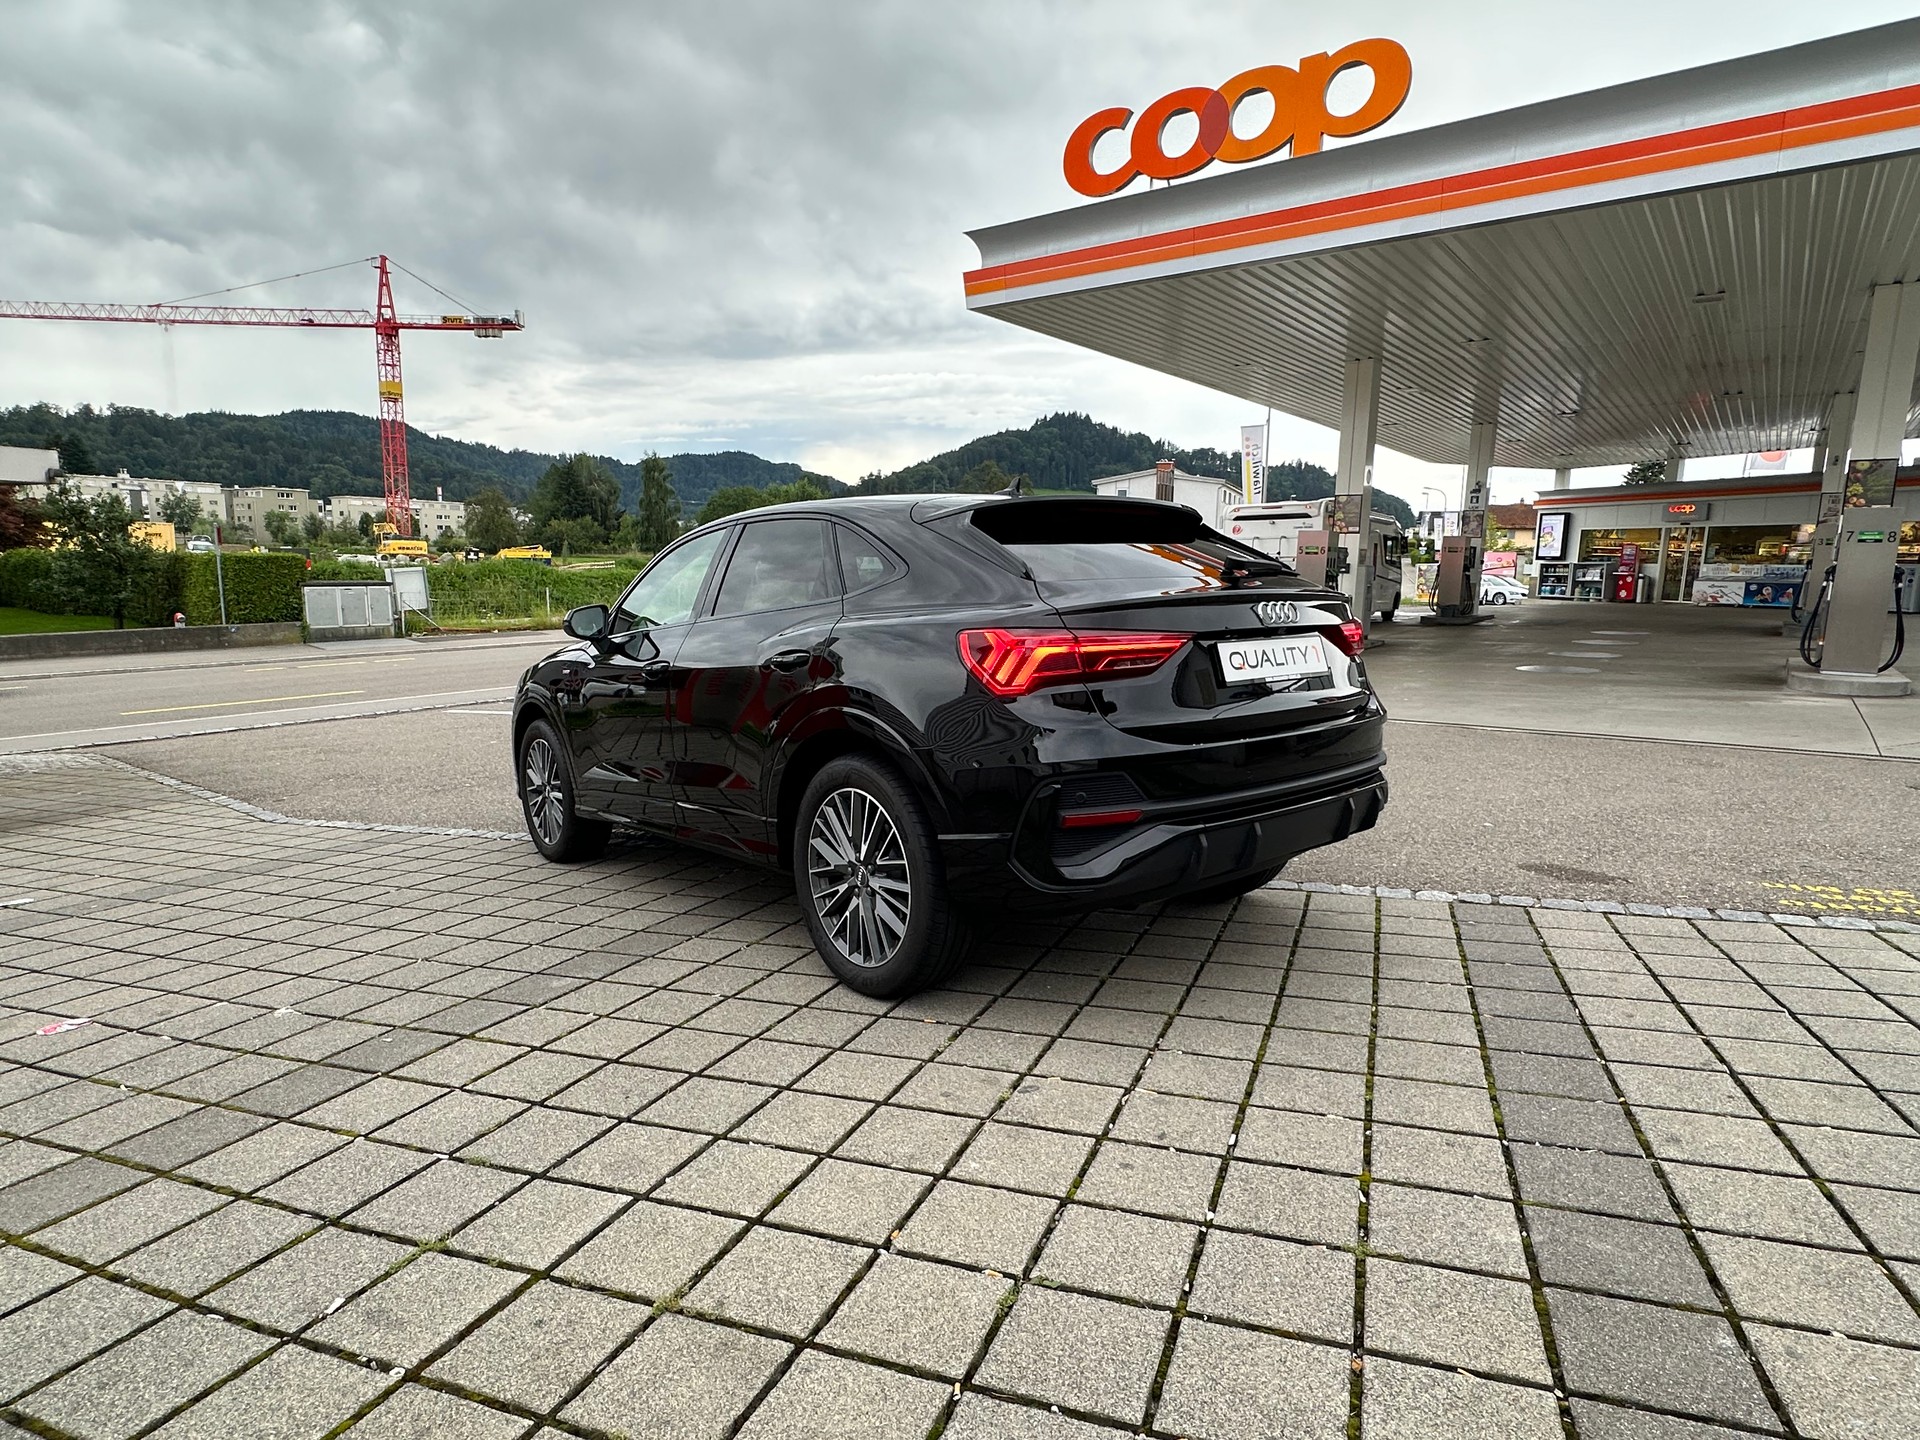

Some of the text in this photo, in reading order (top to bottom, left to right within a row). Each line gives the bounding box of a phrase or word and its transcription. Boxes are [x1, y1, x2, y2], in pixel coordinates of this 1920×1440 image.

[1063, 37, 1412, 198] coop
[1668, 504, 1696, 514] coop
[1846, 530, 1855, 542] 7
[1887, 530, 1897, 543] 8
[1817, 538, 1824, 546] 3
[1298, 545, 1304, 555] 5
[1320, 546, 1326, 555] 6
